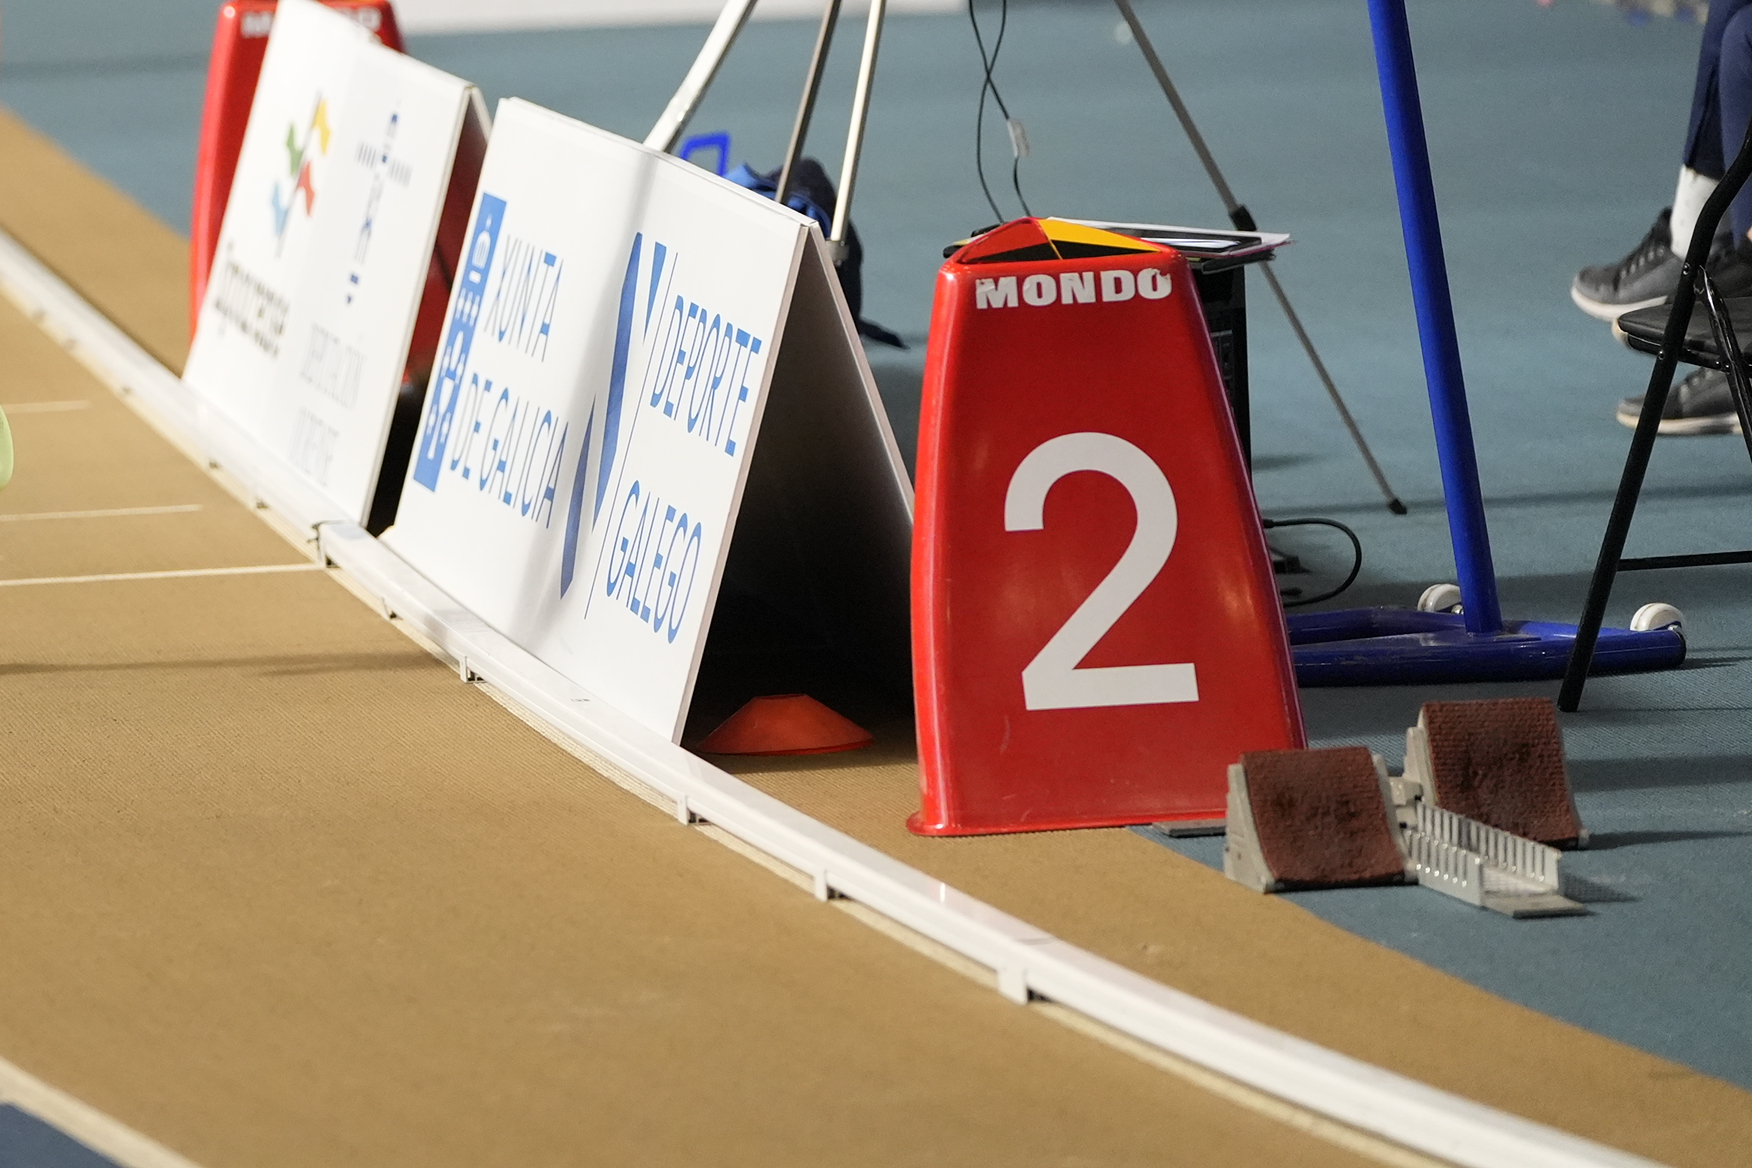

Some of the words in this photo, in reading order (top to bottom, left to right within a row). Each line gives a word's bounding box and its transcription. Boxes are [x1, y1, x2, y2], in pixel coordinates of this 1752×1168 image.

[483, 233, 564, 363] XUNTA
[975, 267, 1173, 310] MONDO
[450, 372, 493, 480] DE
[479, 387, 569, 530] GALICIA
[649, 294, 762, 458] DEPORTE
[606, 480, 702, 645] GALEGO
[1003, 431, 1199, 711] 2
